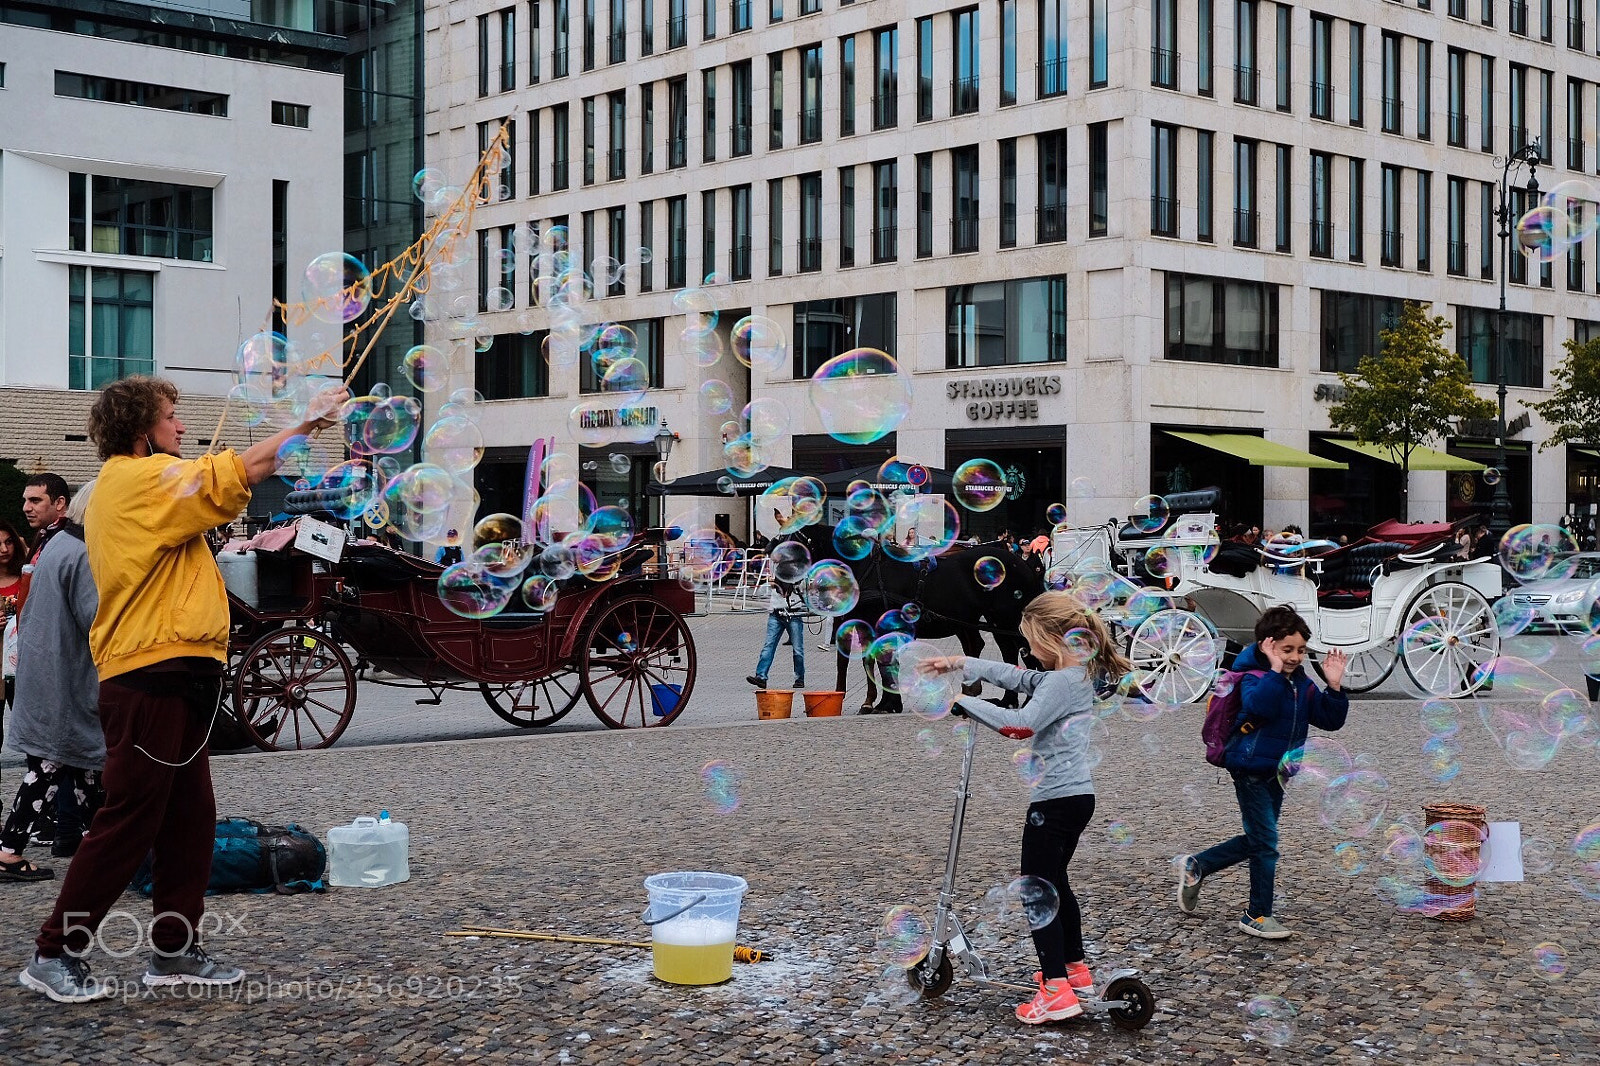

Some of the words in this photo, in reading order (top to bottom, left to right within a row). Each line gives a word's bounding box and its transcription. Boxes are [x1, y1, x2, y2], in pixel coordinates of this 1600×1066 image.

[946, 375, 1061, 399] STARBUCKS
[966, 399, 1039, 421] COFFEE
[964, 484, 993, 492] STARBUCKS
